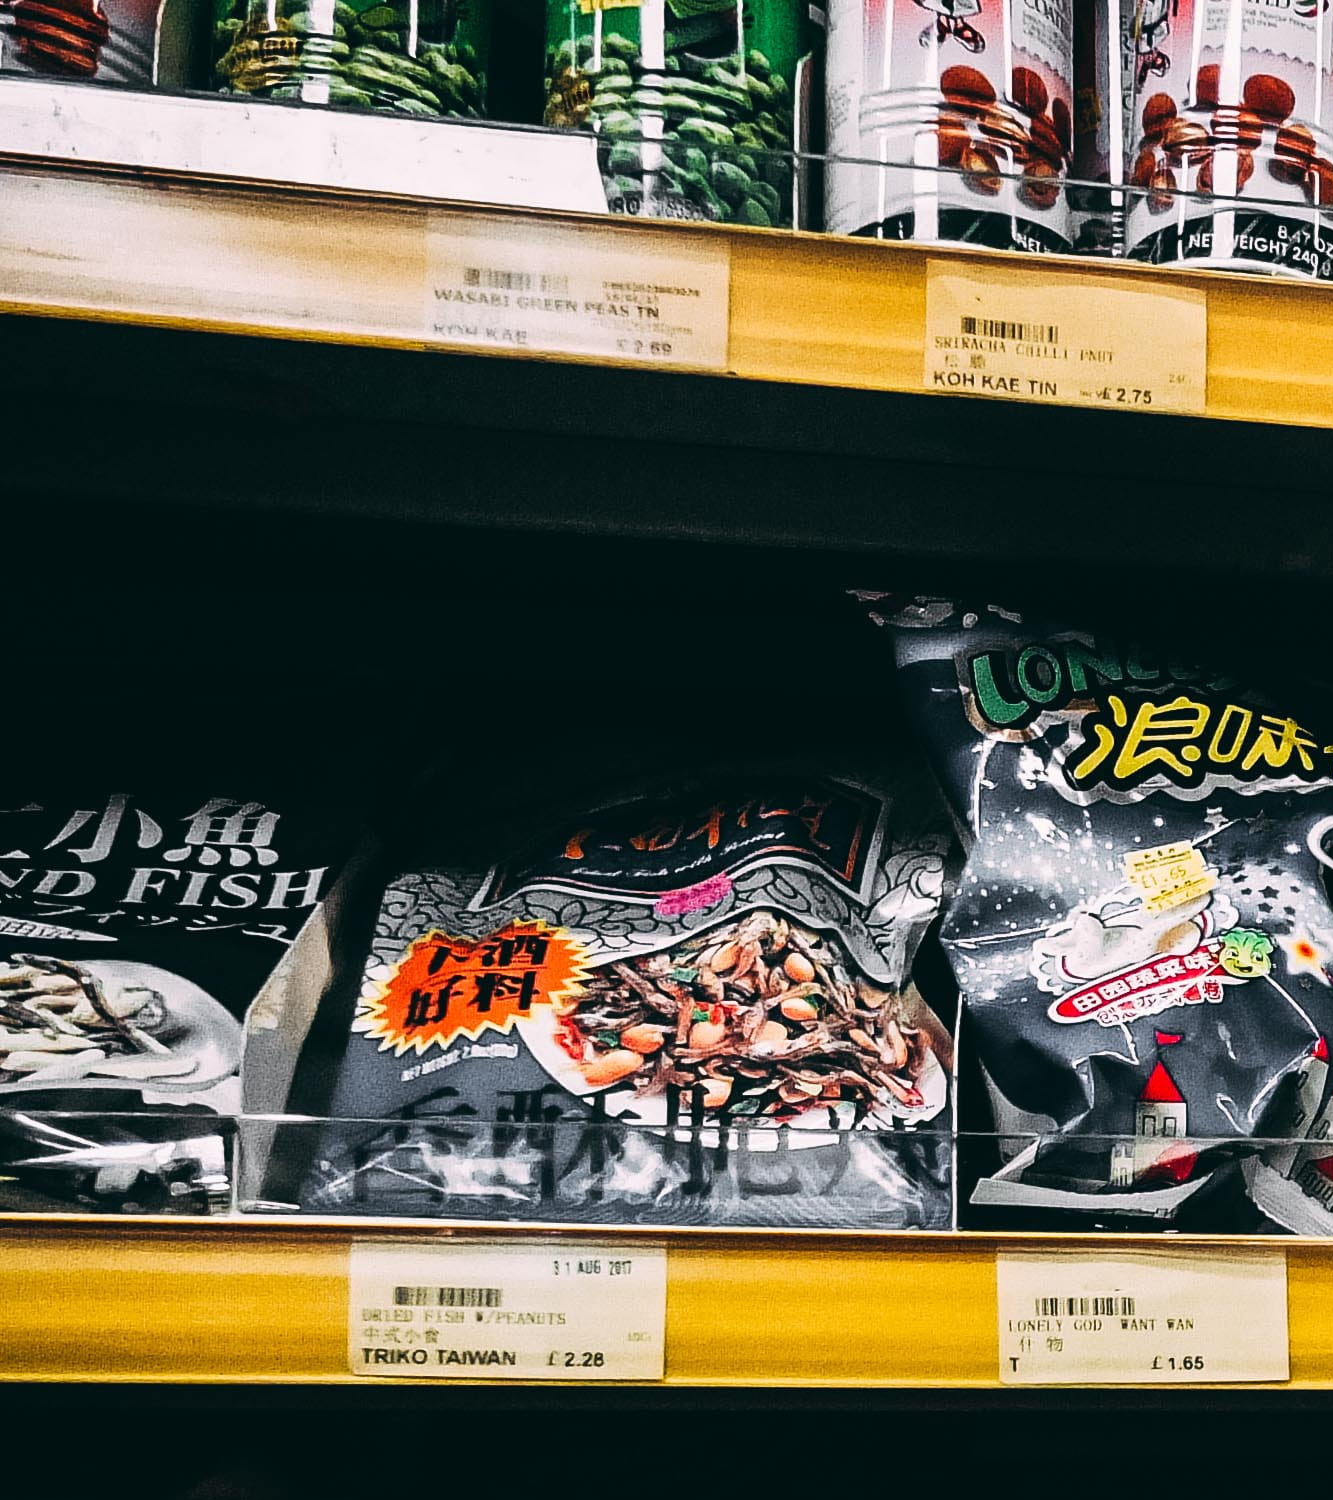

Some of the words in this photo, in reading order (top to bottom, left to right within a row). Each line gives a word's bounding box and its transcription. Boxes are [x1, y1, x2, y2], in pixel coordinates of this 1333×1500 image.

[933, 370, 976, 388] KOH
[981, 375, 1021, 393] KAE
[1028, 380, 1058, 397] TIN
[1116, 389, 1153, 405] 2.75
[121, 866, 333, 912] FISH
[577, 1260, 602, 1275] AUG
[1008, 1318, 1063, 1333] LONELY
[1073, 1318, 1103, 1332] GOD
[1120, 1318, 1158, 1332] WANT
[1167, 1318, 1195, 1331] WAN
[361, 1347, 429, 1366] TRIKO
[436, 1348, 517, 1367] TAIWAN
[564, 1351, 605, 1369] 2.28
[1009, 1356, 1021, 1373] T
[1150, 1356, 1164, 1371] £
[1168, 1356, 1205, 1371] 1.65
